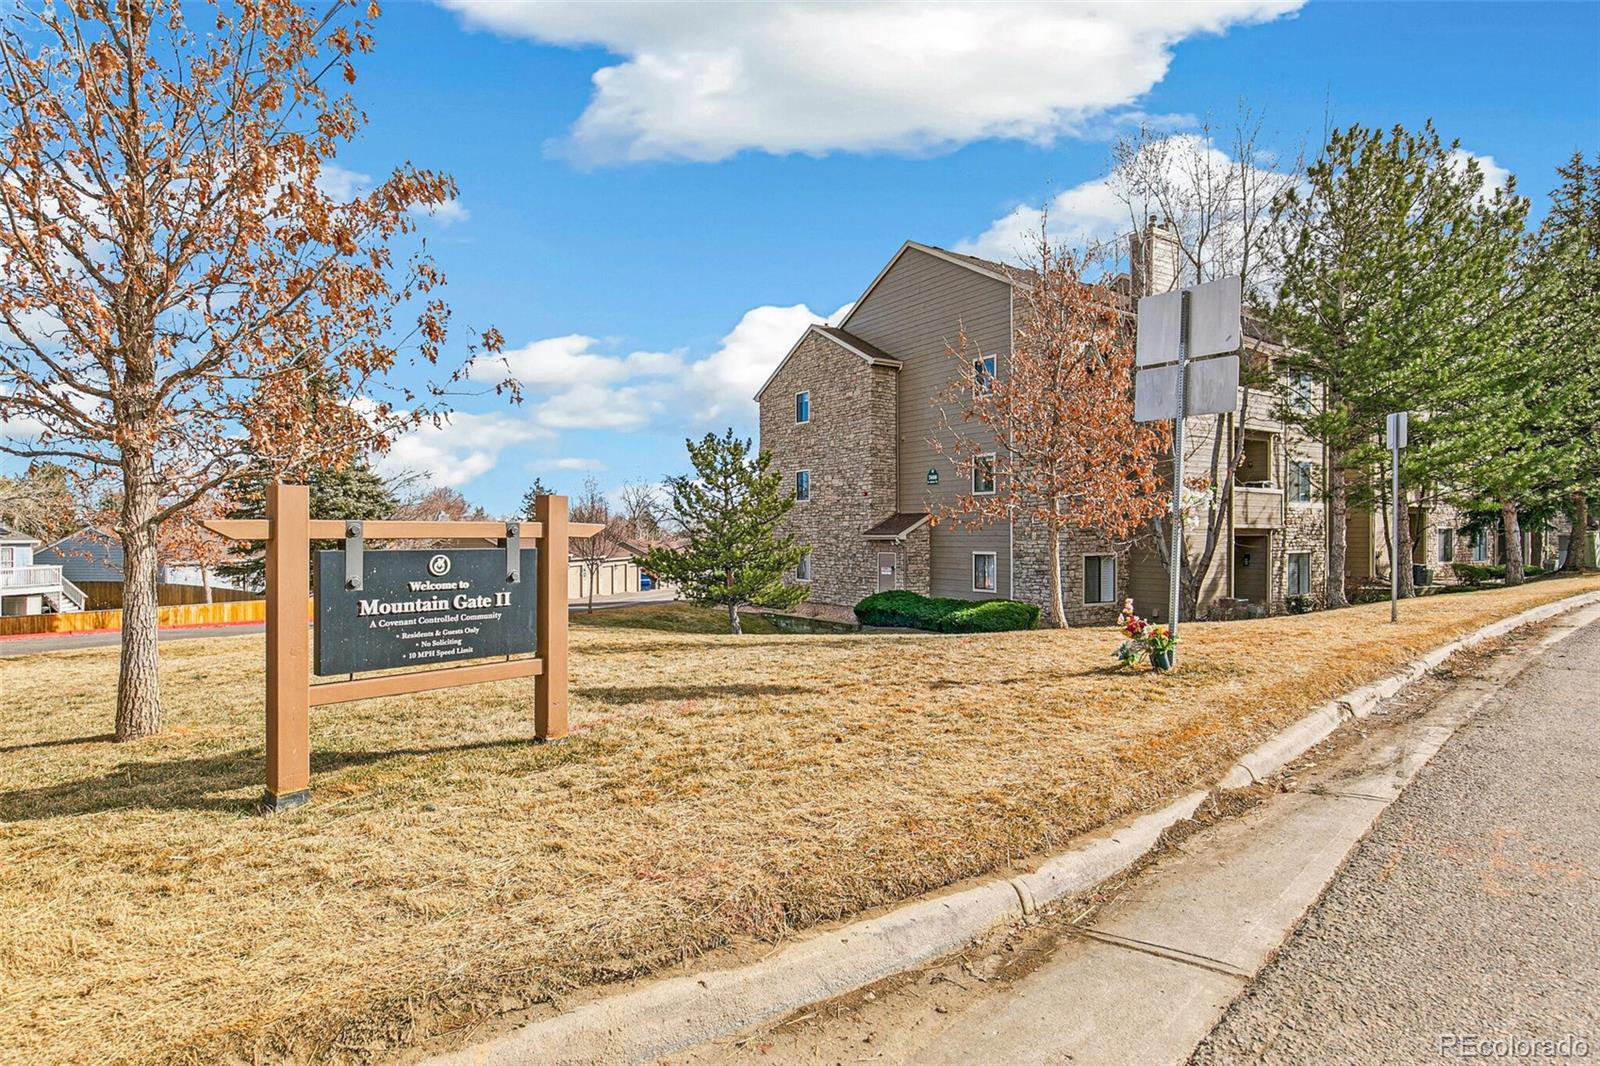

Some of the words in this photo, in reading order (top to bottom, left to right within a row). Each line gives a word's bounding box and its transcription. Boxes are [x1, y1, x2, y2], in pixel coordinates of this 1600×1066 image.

[409, 582, 457, 591] Welcome
[459, 581, 469, 589] to
[359, 596, 449, 616] Mountain
[453, 595, 492, 609] Gate
[495, 592, 511, 606] II
[369, 620, 377, 628] A
[378, 618, 416, 628] Covenant
[418, 615, 458, 624] Controlled
[461, 612, 502, 621] Community
[432, 638, 462, 647] Soliciting
[417, 650, 435, 659] MPH
[436, 648, 455, 658] Speed
